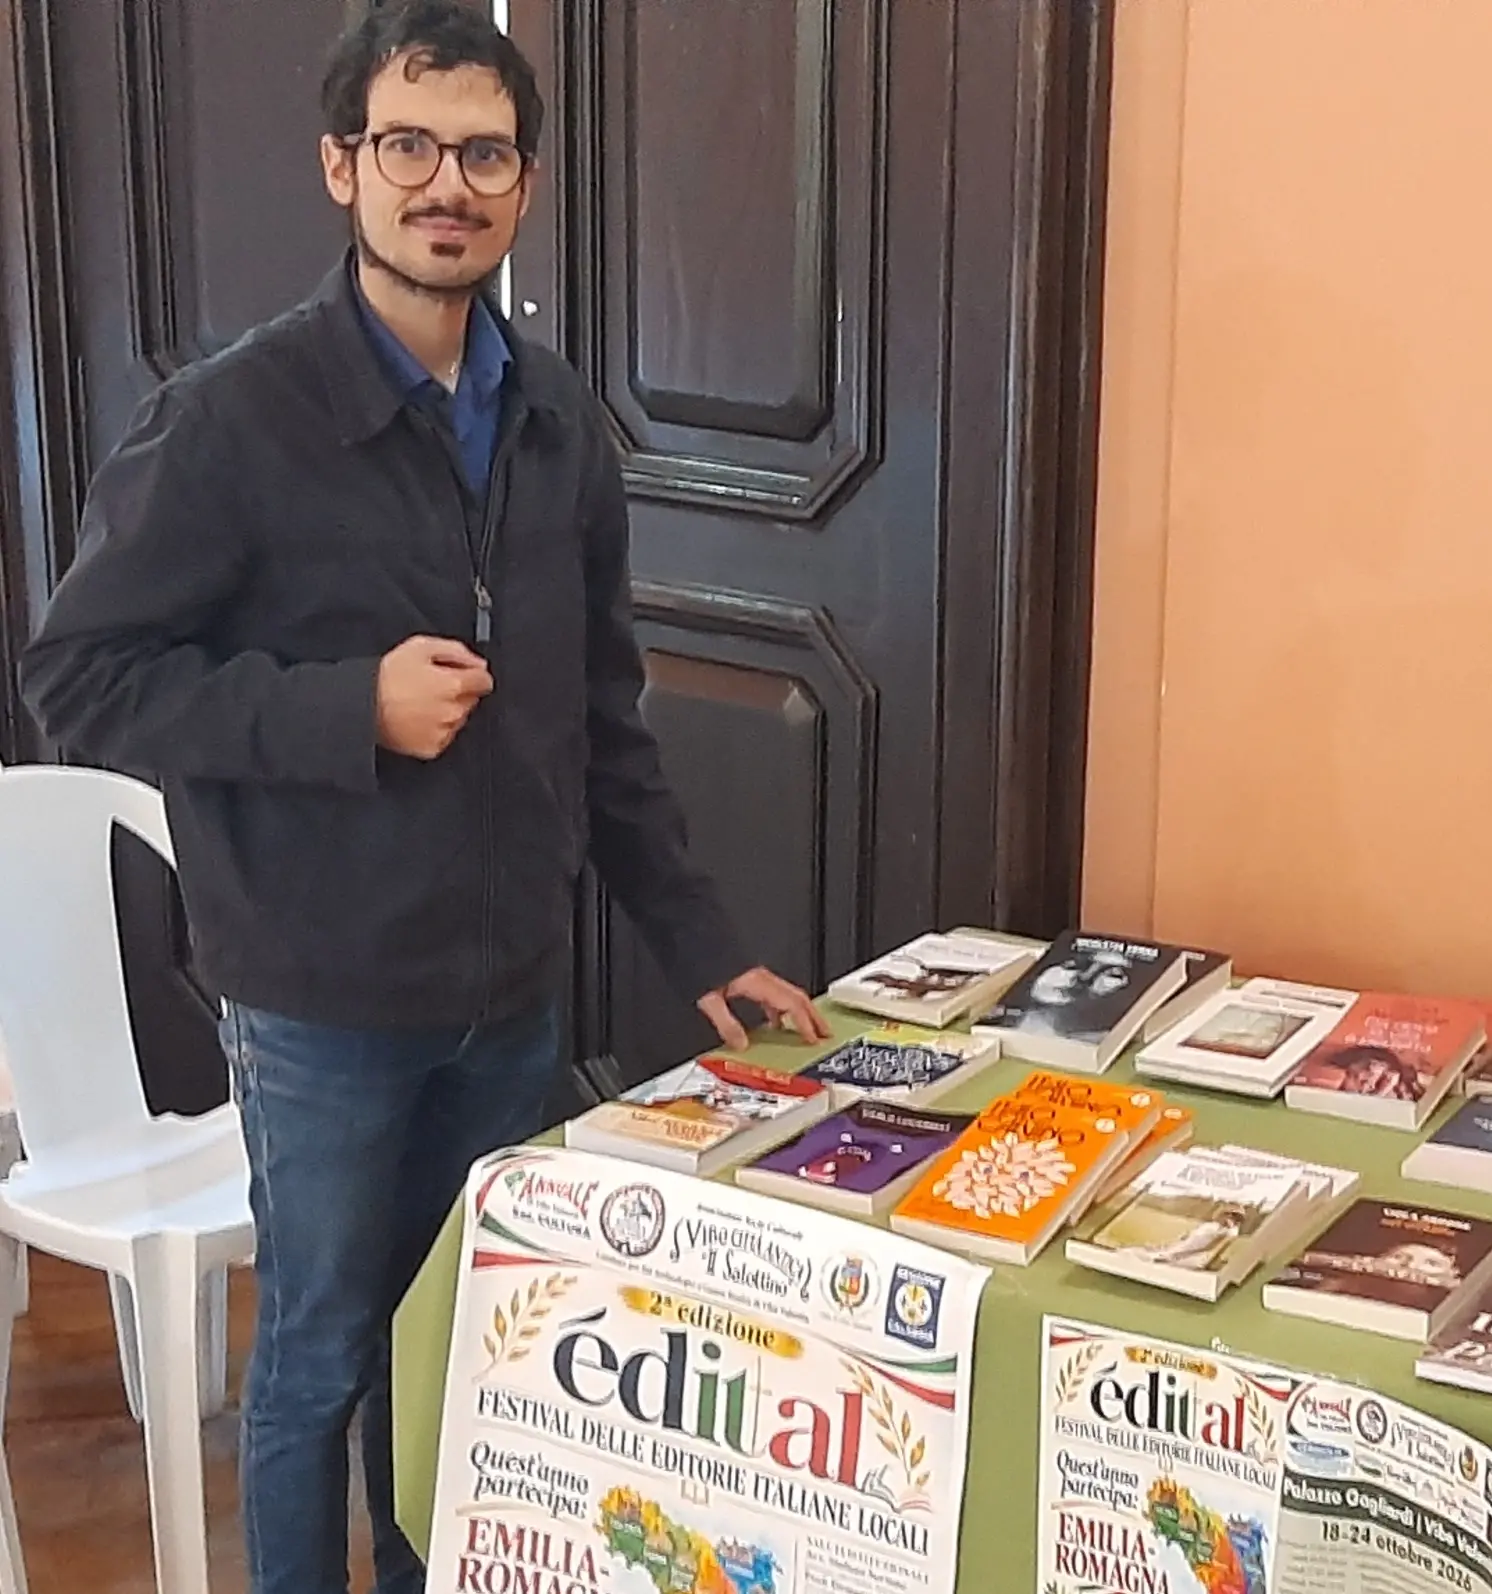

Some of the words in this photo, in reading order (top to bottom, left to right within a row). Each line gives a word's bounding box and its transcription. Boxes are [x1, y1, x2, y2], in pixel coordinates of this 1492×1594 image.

[676, 1301, 777, 1351] edizione
[469, 1439, 590, 1496] Quest'anno
[477, 1386, 577, 1440] FESTIVAL
[581, 1415, 646, 1463] DELLE
[651, 1437, 748, 1496] EDITORIE
[751, 1472, 851, 1532] ITALIANE
[858, 1506, 929, 1557] LOCALI
[1054, 1414, 1103, 1444] FESTIVAL
[1193, 1447, 1241, 1481] ITALIANE
[1243, 1461, 1277, 1491] LOCALI
[1282, 1477, 1343, 1506] Palazzo
[467, 1516, 610, 1586] EMILIA-
[1055, 1543, 1169, 1594] ROMAGNA
[1375, 1532, 1433, 1571] ottobre
[1436, 1557, 1474, 1592] 2026
